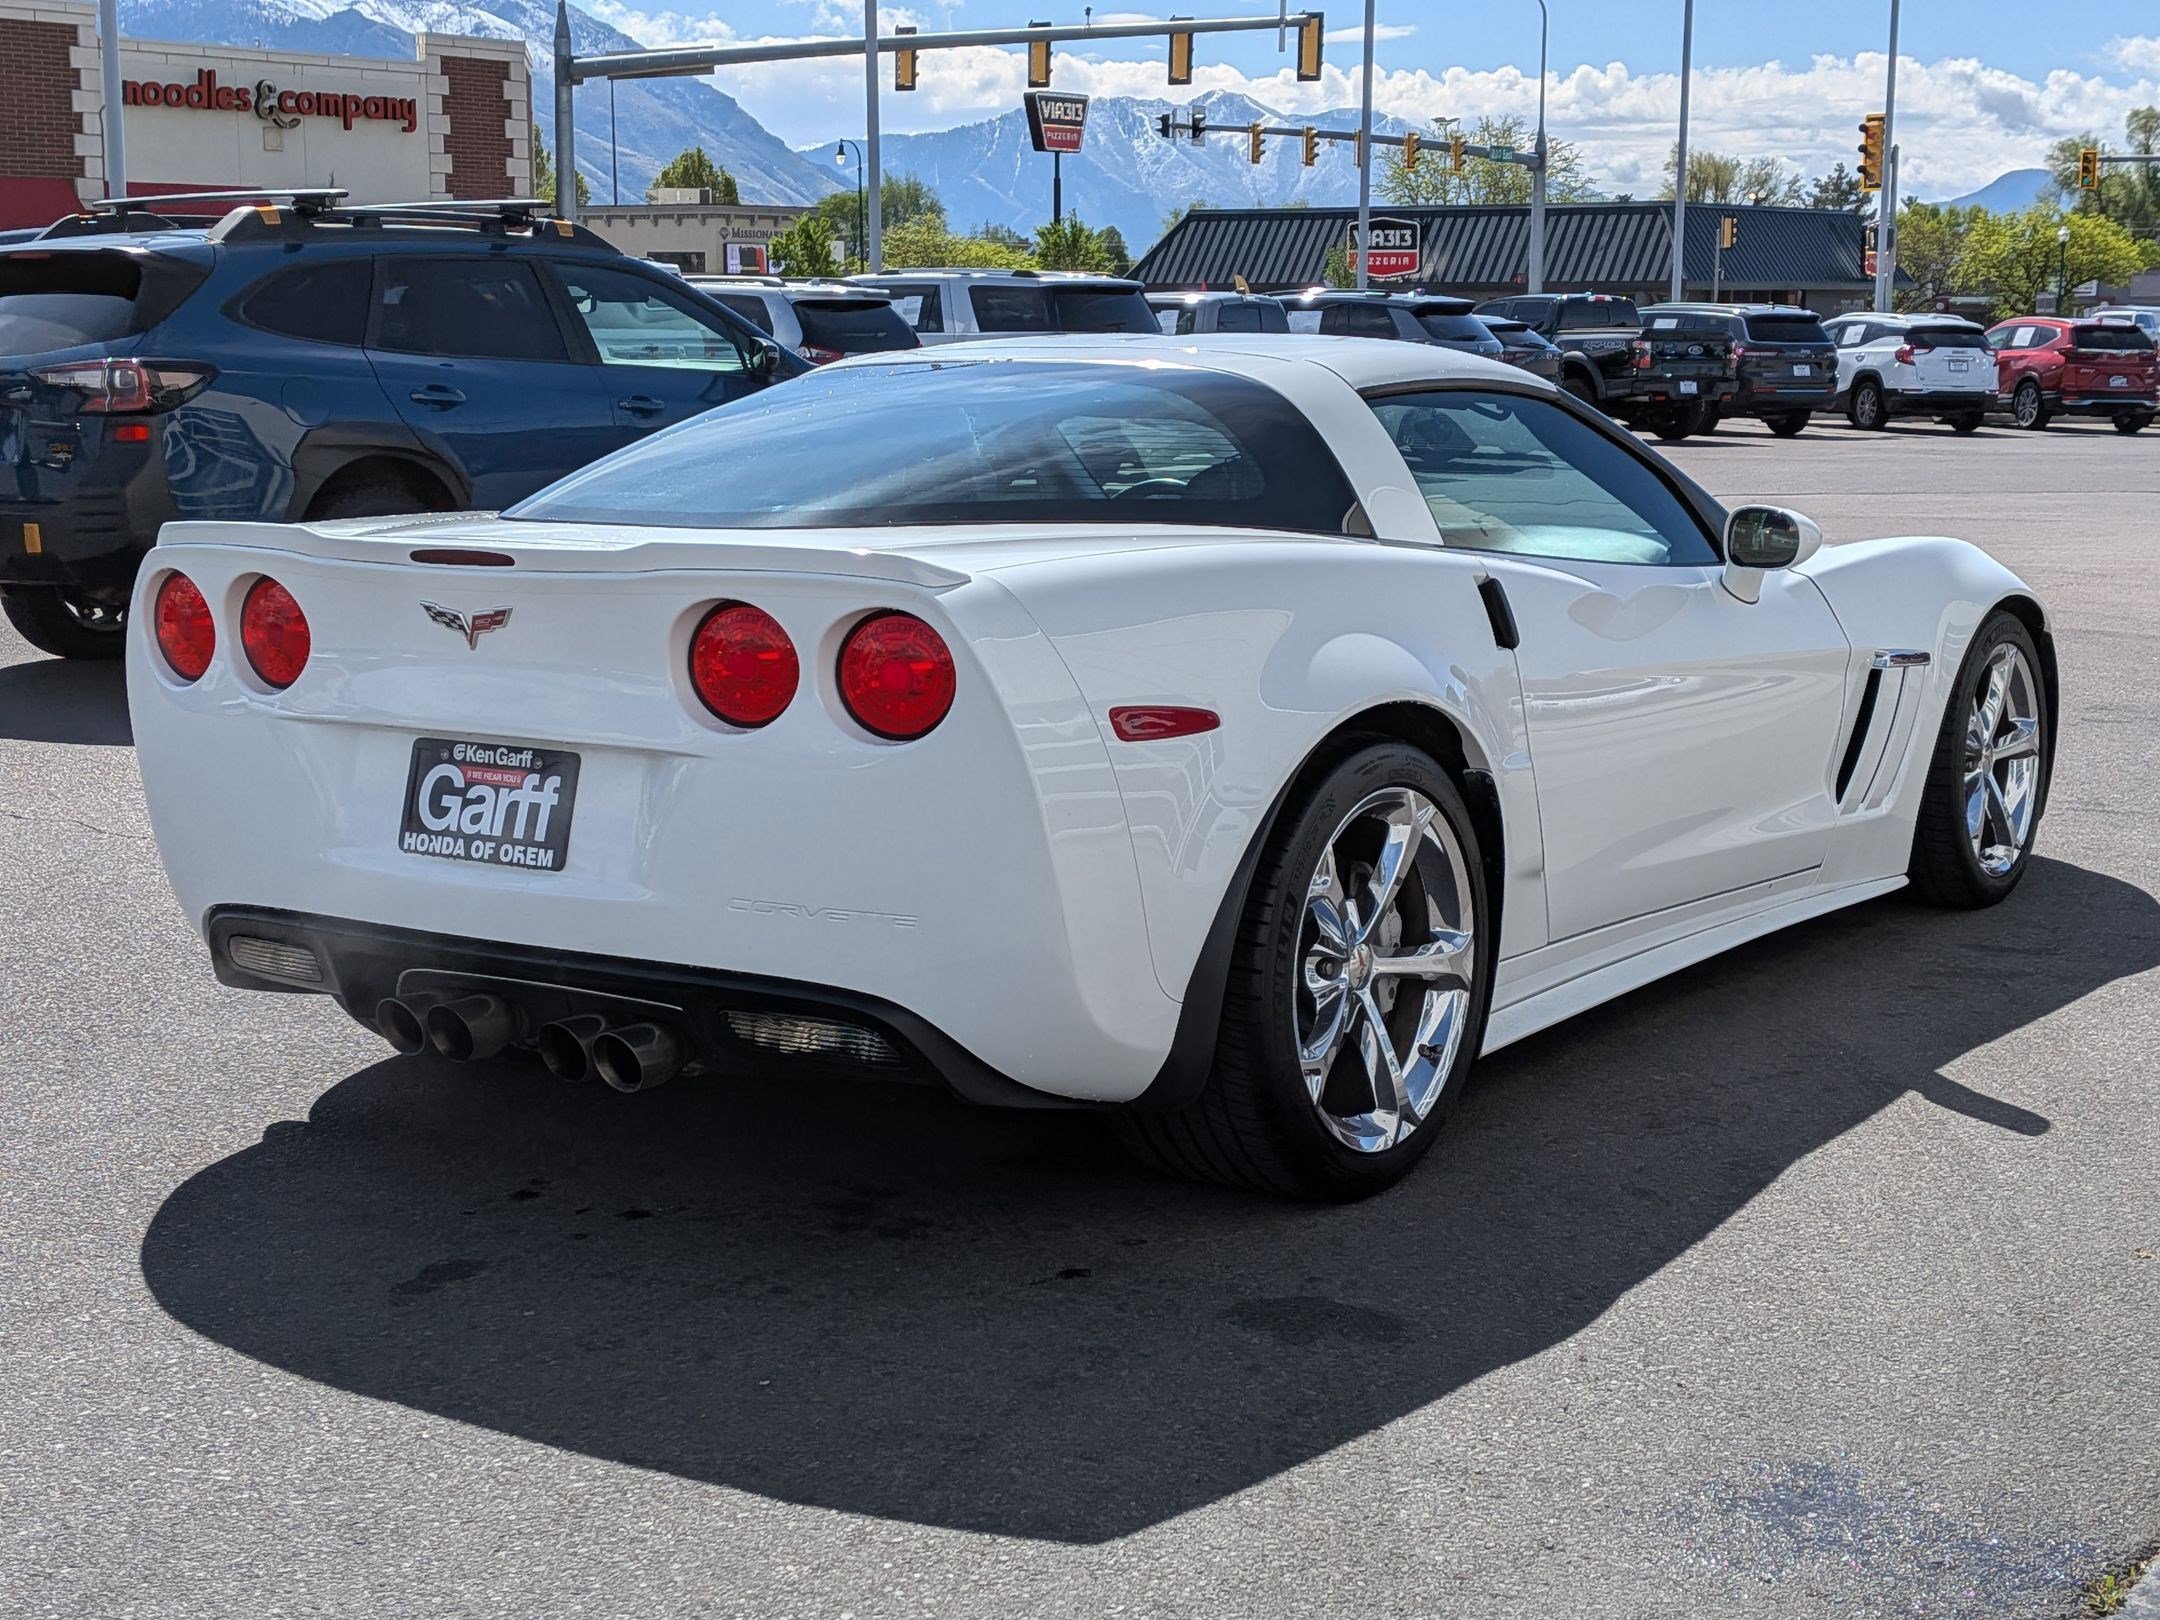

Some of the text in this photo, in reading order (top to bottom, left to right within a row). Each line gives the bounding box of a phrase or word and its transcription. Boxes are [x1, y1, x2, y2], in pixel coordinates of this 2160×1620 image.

[122, 68, 417, 132] noodles & company
[1041, 100, 1084, 121] VIA313
[465, 746, 534, 769] Ken Garff
[503, 773, 517, 783] YOU
[418, 763, 562, 842] Garff
[403, 831, 554, 868] HONDA OF OREM
[728, 897, 919, 928] CORVETTE
